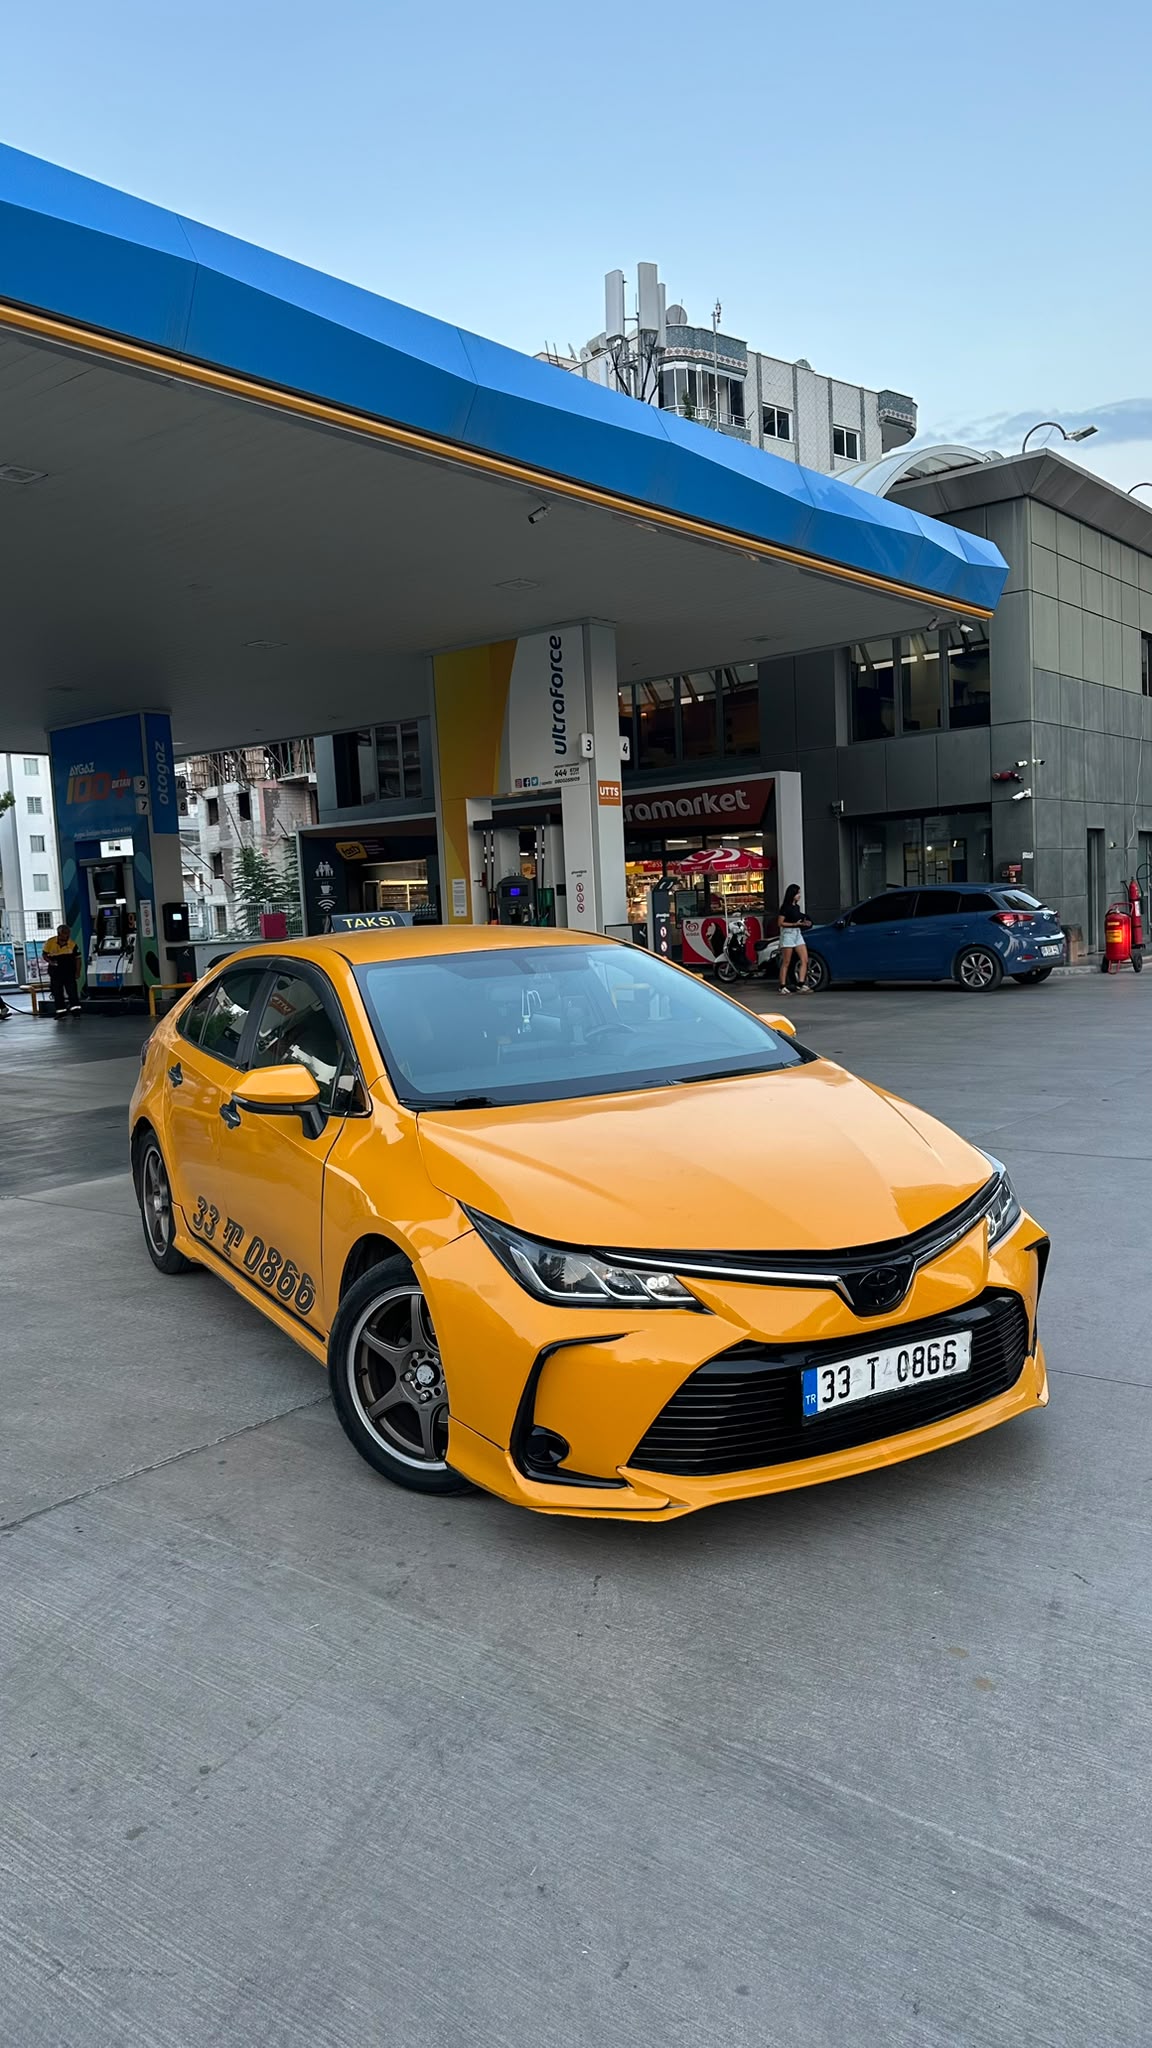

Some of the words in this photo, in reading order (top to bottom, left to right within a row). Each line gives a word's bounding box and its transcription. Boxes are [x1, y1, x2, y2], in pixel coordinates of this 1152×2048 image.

[549, 635, 567, 755] ultraforce
[585, 739, 592, 751] 3
[622, 742, 628, 754] 4
[69, 762, 95, 777] AYGAZ
[155, 740, 170, 805] otogaz
[139, 780, 146, 789] 9
[177, 780, 187, 790] 10
[599, 786, 620, 797] UTTS
[141, 801, 148, 811] 7
[180, 802, 186, 811] 8
[623, 789, 750, 823] ramarket
[192, 1195, 221, 1240] 33
[222, 1217, 245, 1258] T
[243, 1235, 316, 1316] 0866
[821, 1364, 851, 1403] 33
[867, 1356, 880, 1391] T
[897, 1339, 957, 1382] 0866
[805, 1393, 817, 1405] TR
